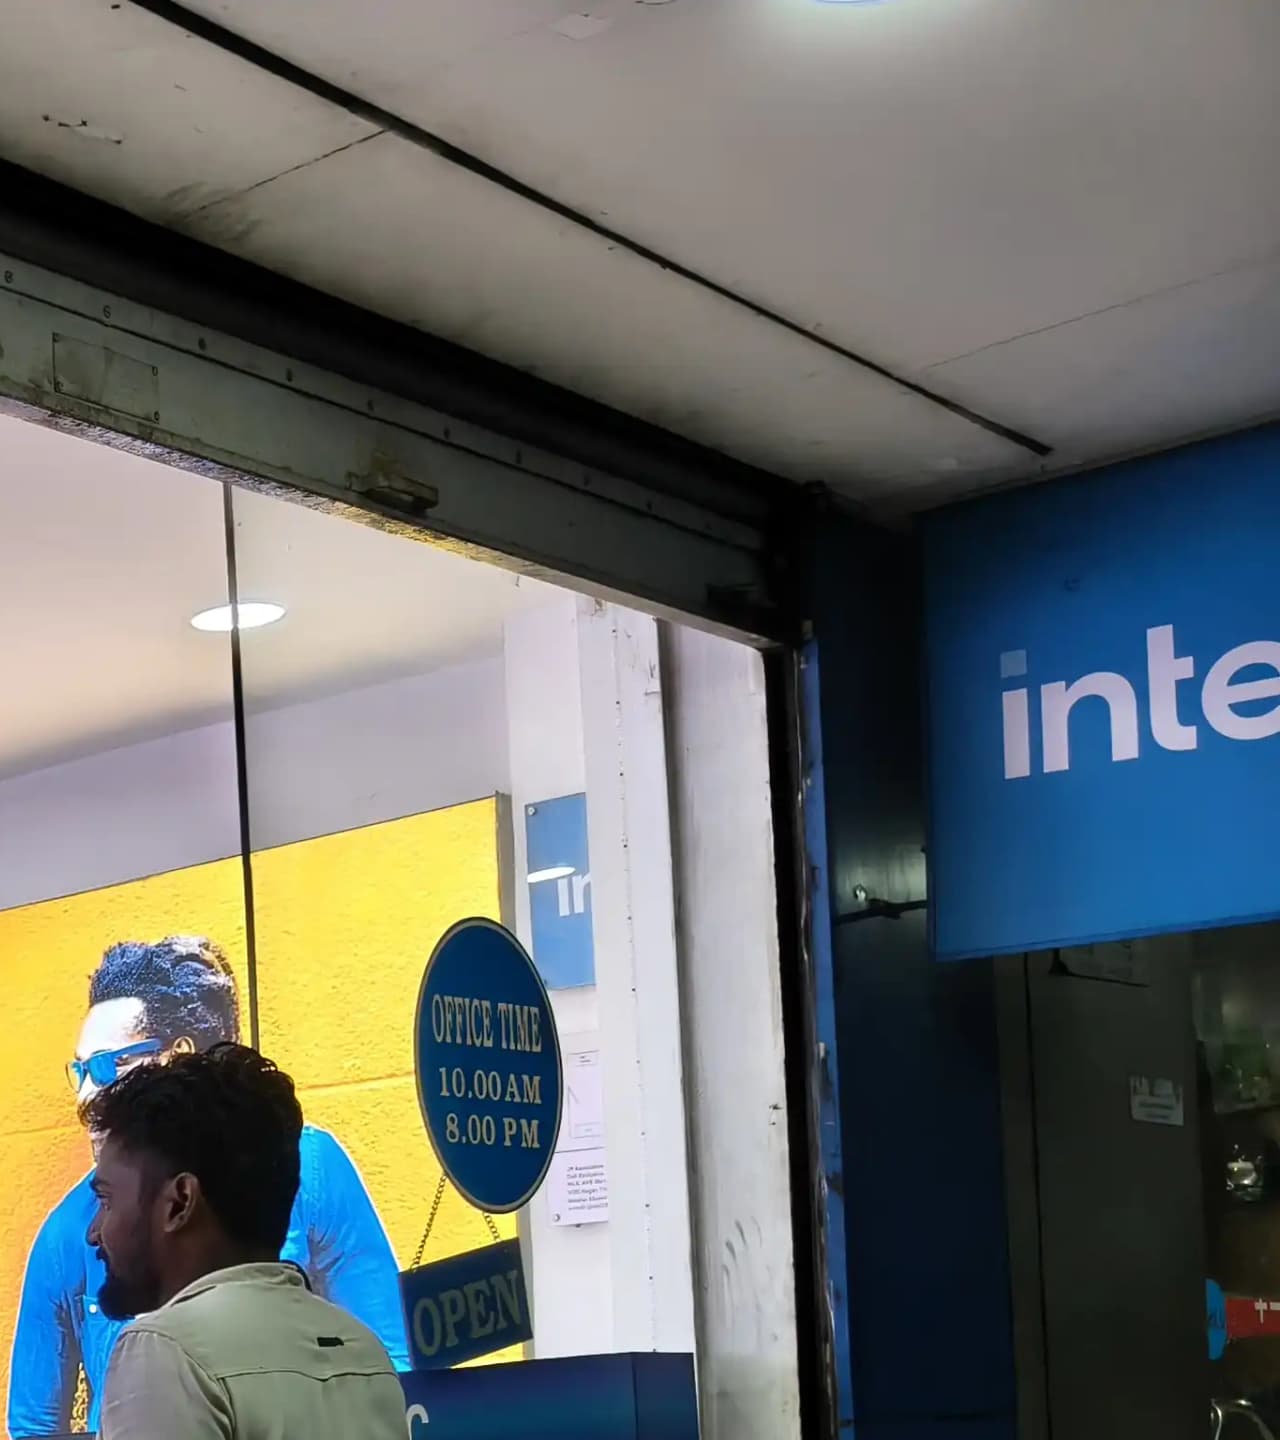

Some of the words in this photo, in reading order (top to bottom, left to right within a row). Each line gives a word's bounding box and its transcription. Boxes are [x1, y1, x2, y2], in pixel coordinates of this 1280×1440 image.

[1000, 624, 1280, 780] inte
[432, 993, 494, 1048] OFFICE
[497, 1003, 542, 1053] TIME
[439, 1066, 502, 1101] 10.00
[504, 1073, 542, 1104] AM
[446, 1113, 496, 1145] 8.00
[503, 1117, 541, 1148] PM
[413, 1269, 522, 1357] OPEN
